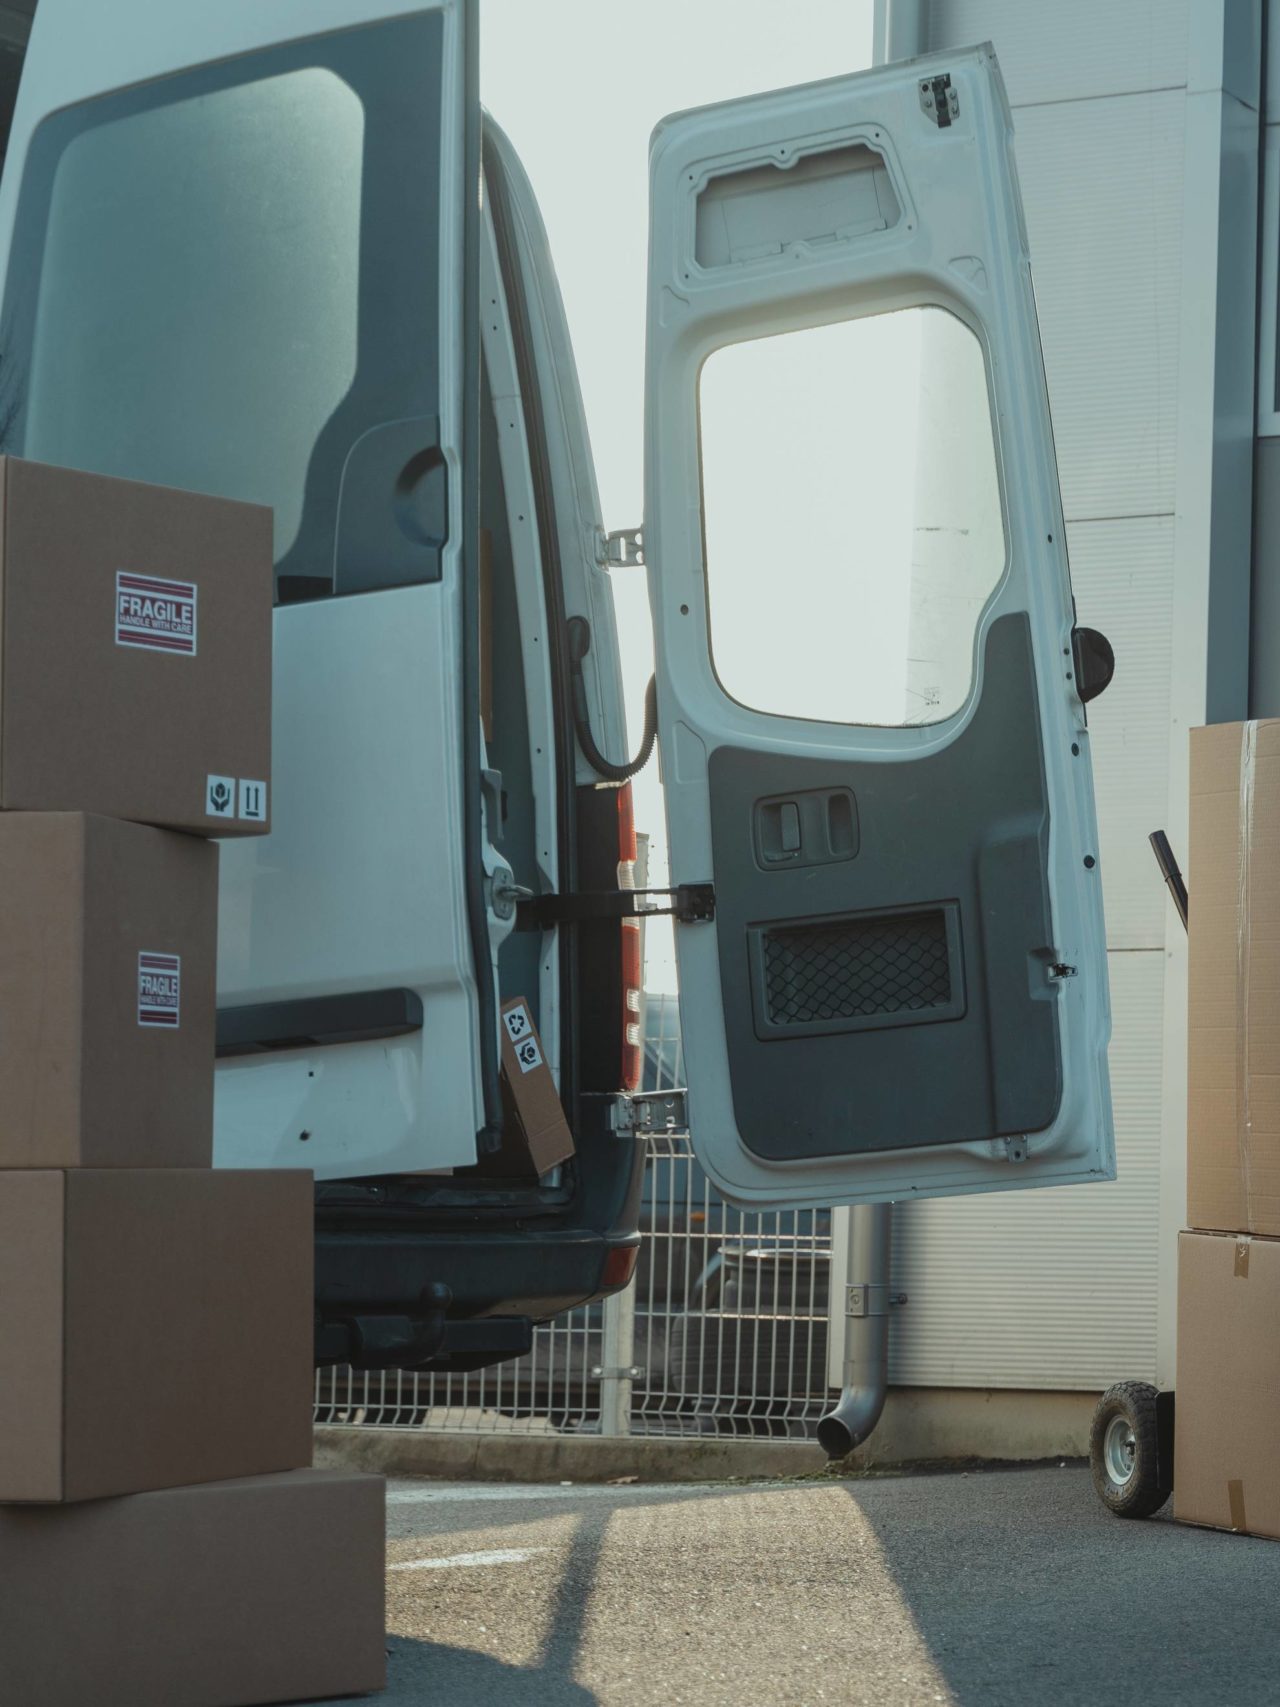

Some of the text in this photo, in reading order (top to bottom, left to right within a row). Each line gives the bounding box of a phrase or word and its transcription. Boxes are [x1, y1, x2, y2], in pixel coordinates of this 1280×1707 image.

[120, 595, 192, 624] FRAGILE
[120, 615, 192, 633] HANDLE WITH CARE
[140, 975, 177, 996] FRAGILE
